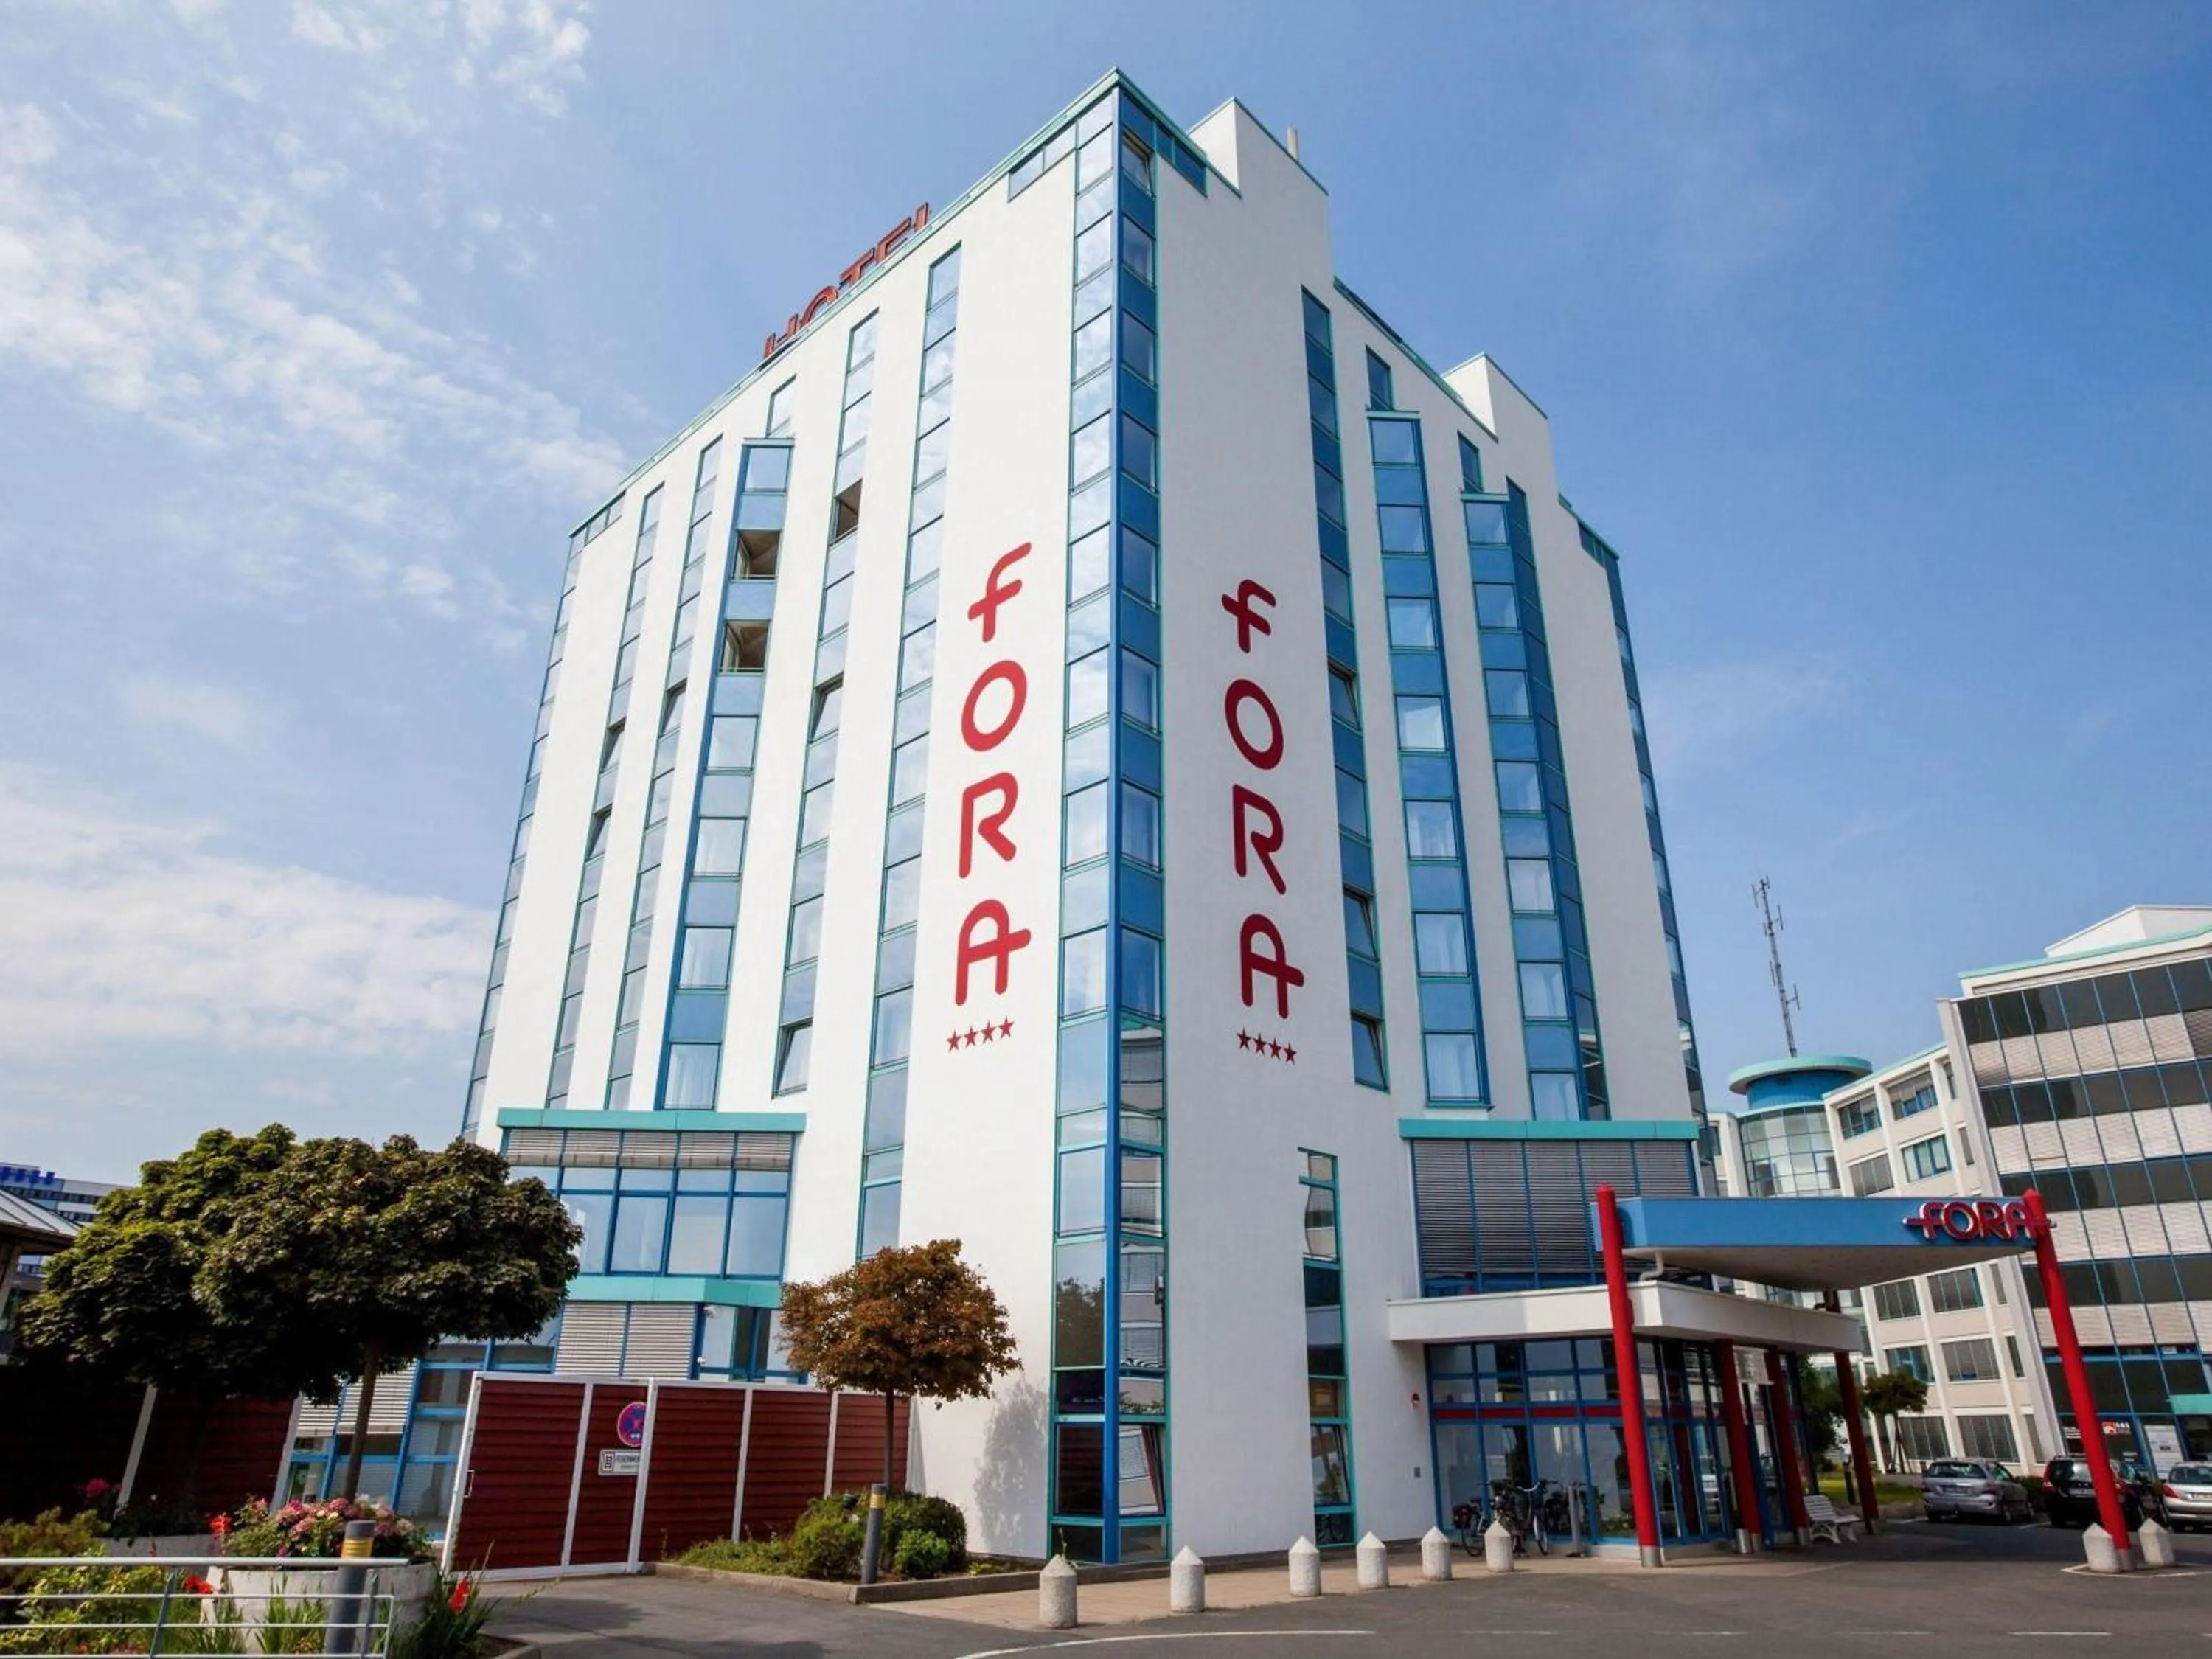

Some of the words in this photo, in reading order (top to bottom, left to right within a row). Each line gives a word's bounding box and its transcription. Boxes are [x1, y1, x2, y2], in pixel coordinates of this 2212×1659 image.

[955, 542, 1032, 1006] FORA
[1222, 579, 1304, 1019] FORA
[1902, 1200, 2057, 1240] FORA
